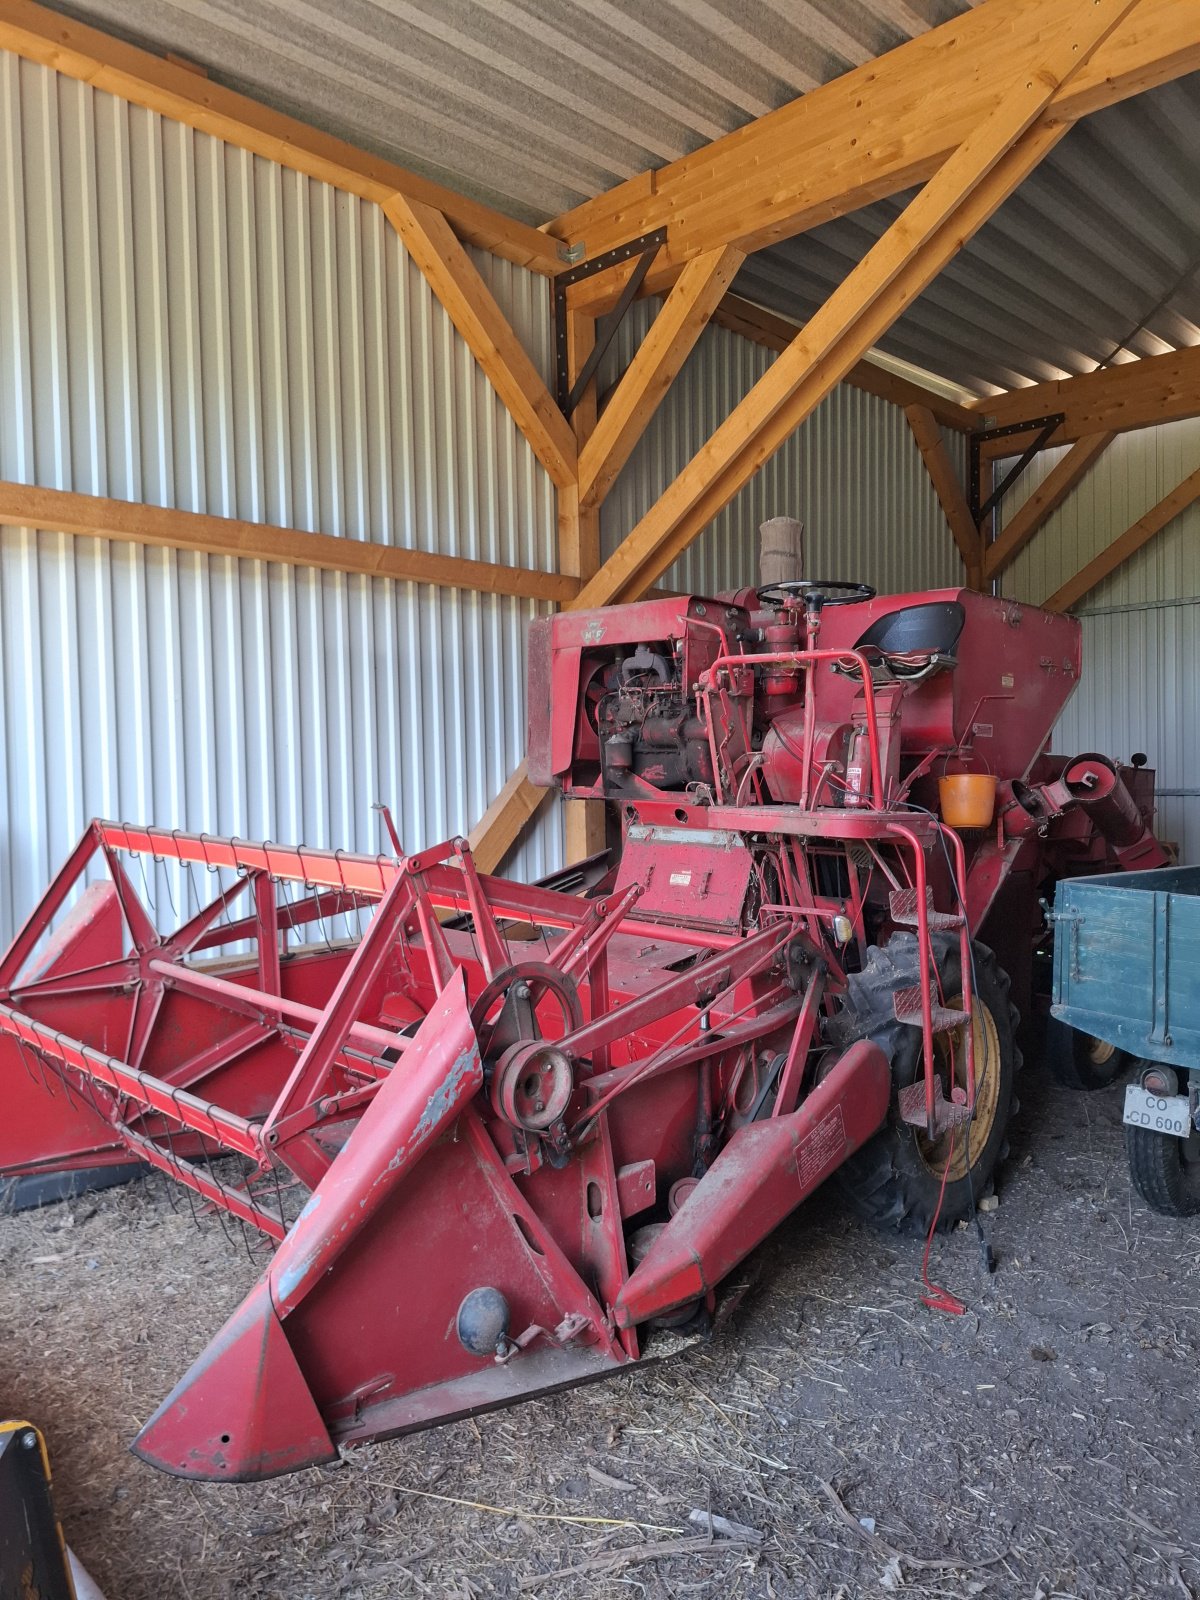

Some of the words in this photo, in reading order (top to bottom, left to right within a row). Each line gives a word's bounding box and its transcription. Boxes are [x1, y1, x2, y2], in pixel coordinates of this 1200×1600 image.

[1145, 1096, 1168, 1111] CO
[1130, 1111, 1151, 1125] CD
[1155, 1116, 1182, 1133] 600
